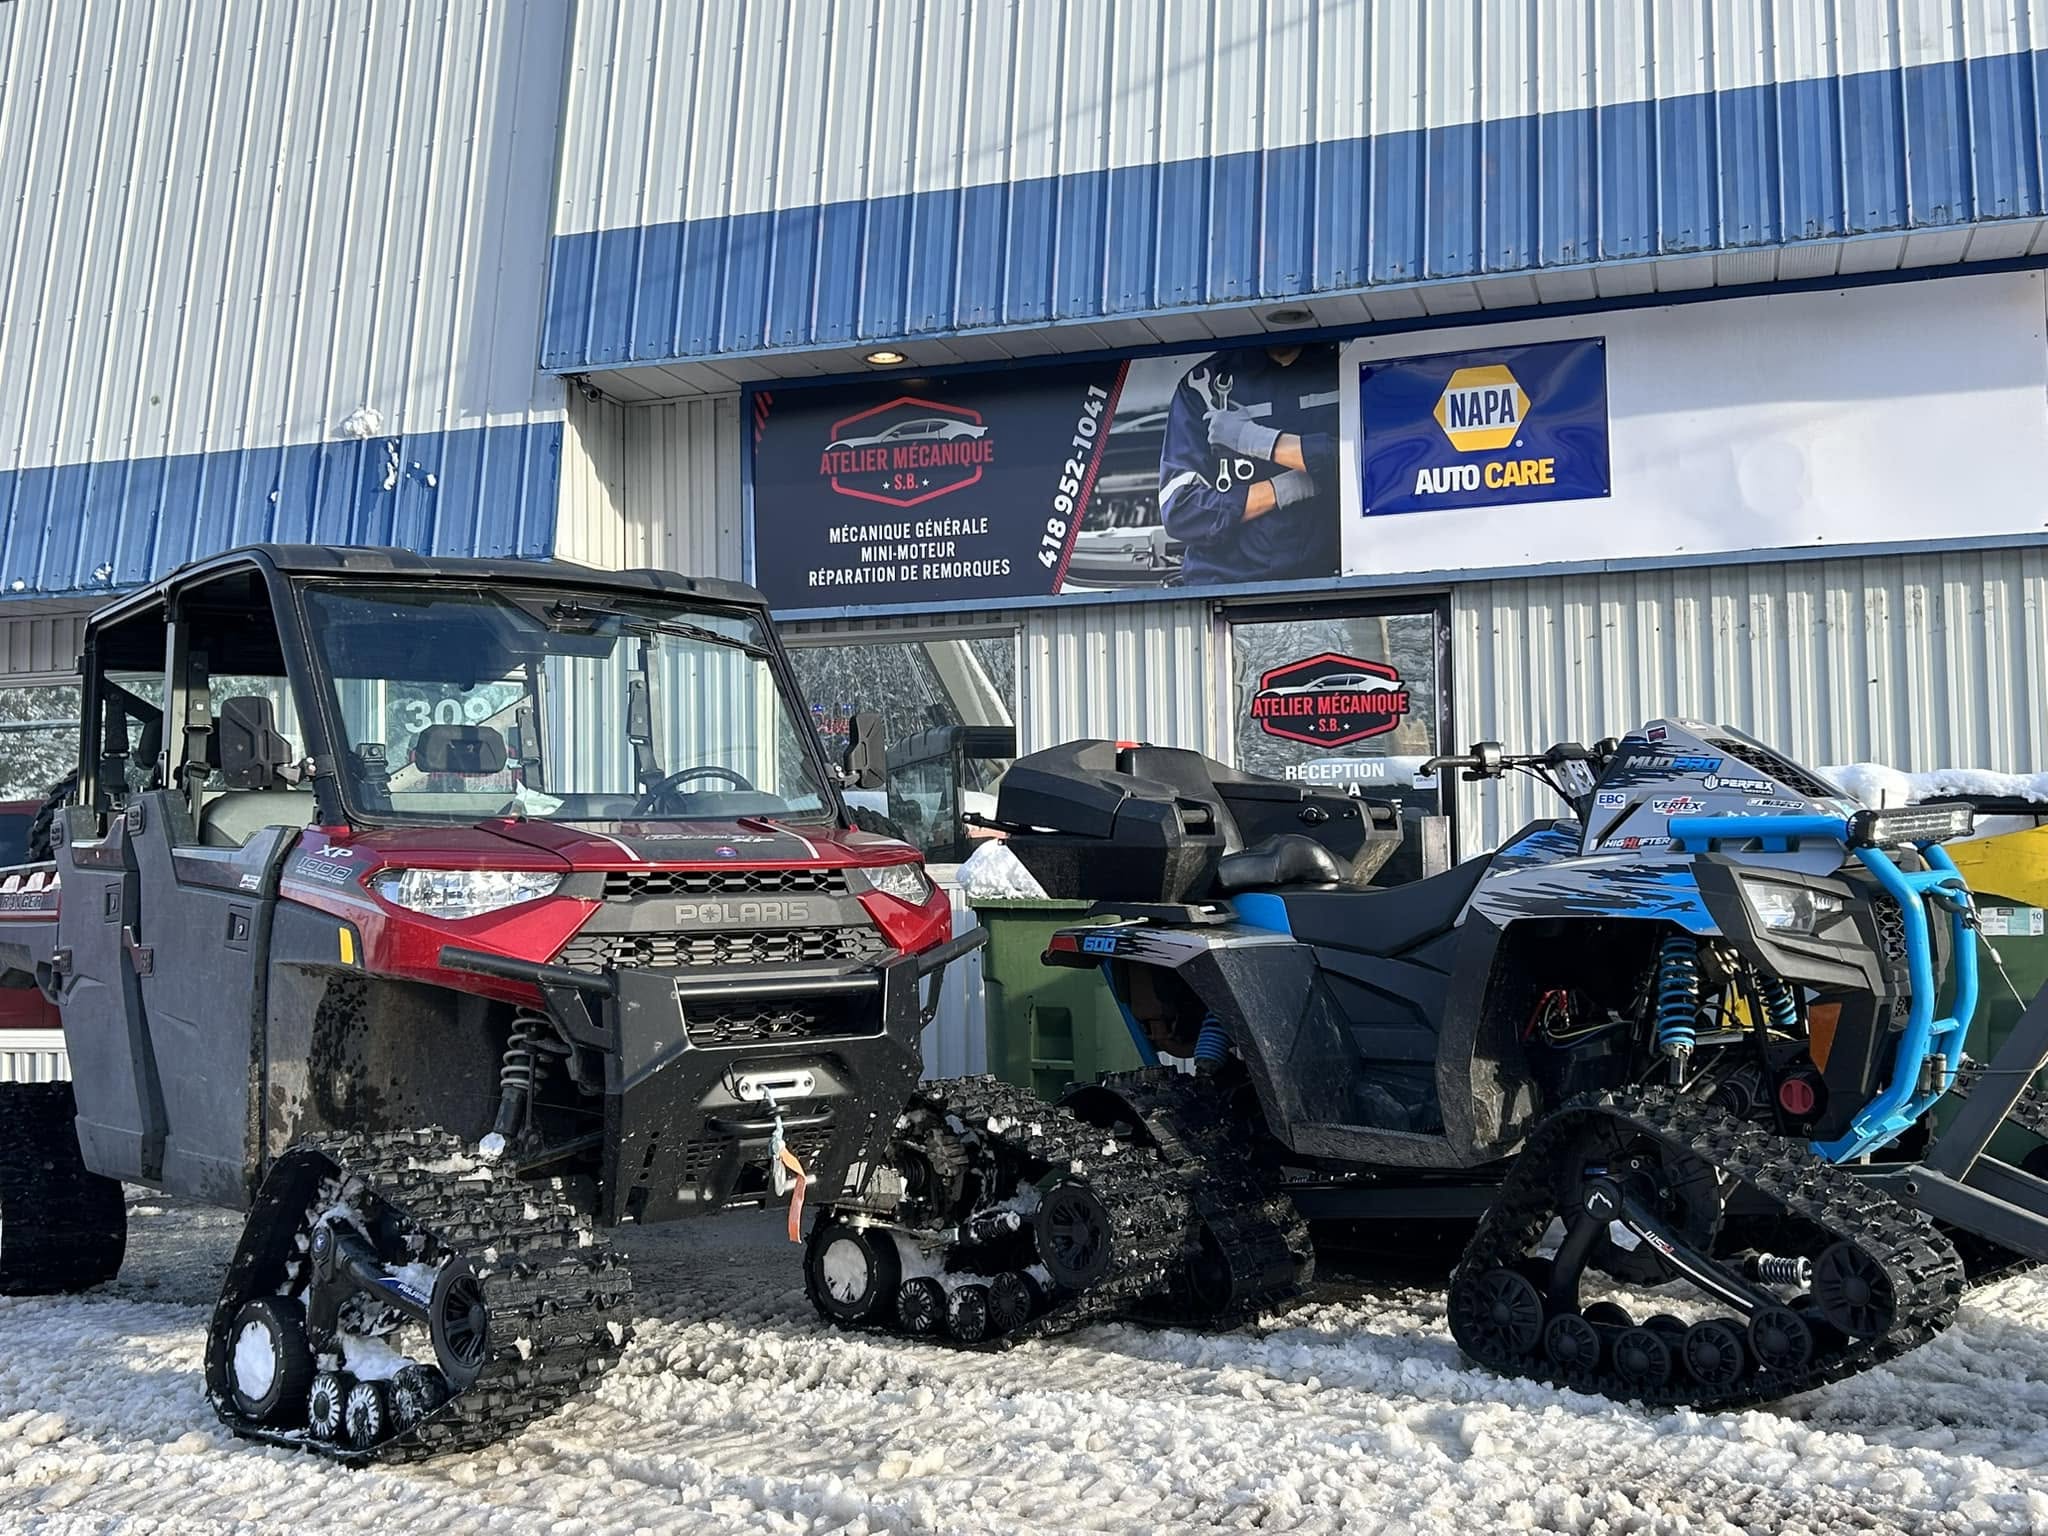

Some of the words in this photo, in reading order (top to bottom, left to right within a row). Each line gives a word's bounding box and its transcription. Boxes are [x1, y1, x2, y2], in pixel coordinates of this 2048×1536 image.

[1450, 388, 1516, 428] NAPA
[820, 446, 887, 475] ATELIER
[893, 440, 994, 470] MÉCANIQUE
[894, 473, 919, 491] S.B.
[1038, 518, 1066, 569] 418
[1054, 384, 1108, 515] 952-1041
[1414, 464, 1480, 495] AUTO
[1485, 458, 1555, 488] CARE
[829, 521, 911, 545] MÉCANIQUE
[915, 517, 989, 540] GÉNÉRALE
[861, 543, 955, 562] MINI-MOTEUR
[809, 565, 896, 587] RÉPARATION
[901, 564, 918, 582] DE
[922, 559, 1011, 581] REMORQUES
[1253, 696, 1313, 717] ATELIER
[1318, 692, 1408, 715] MÉCANIQUE
[1319, 718, 1341, 732] S.B.
[1286, 762, 1384, 780] RÉCEPTION
[1599, 794, 1624, 804] EBC
[1654, 801, 1701, 811] VERTEX
[315, 844, 353, 858] XP
[297, 856, 354, 881] 1000
[675, 901, 809, 925] POLARIS
[1083, 936, 1117, 952] 600
